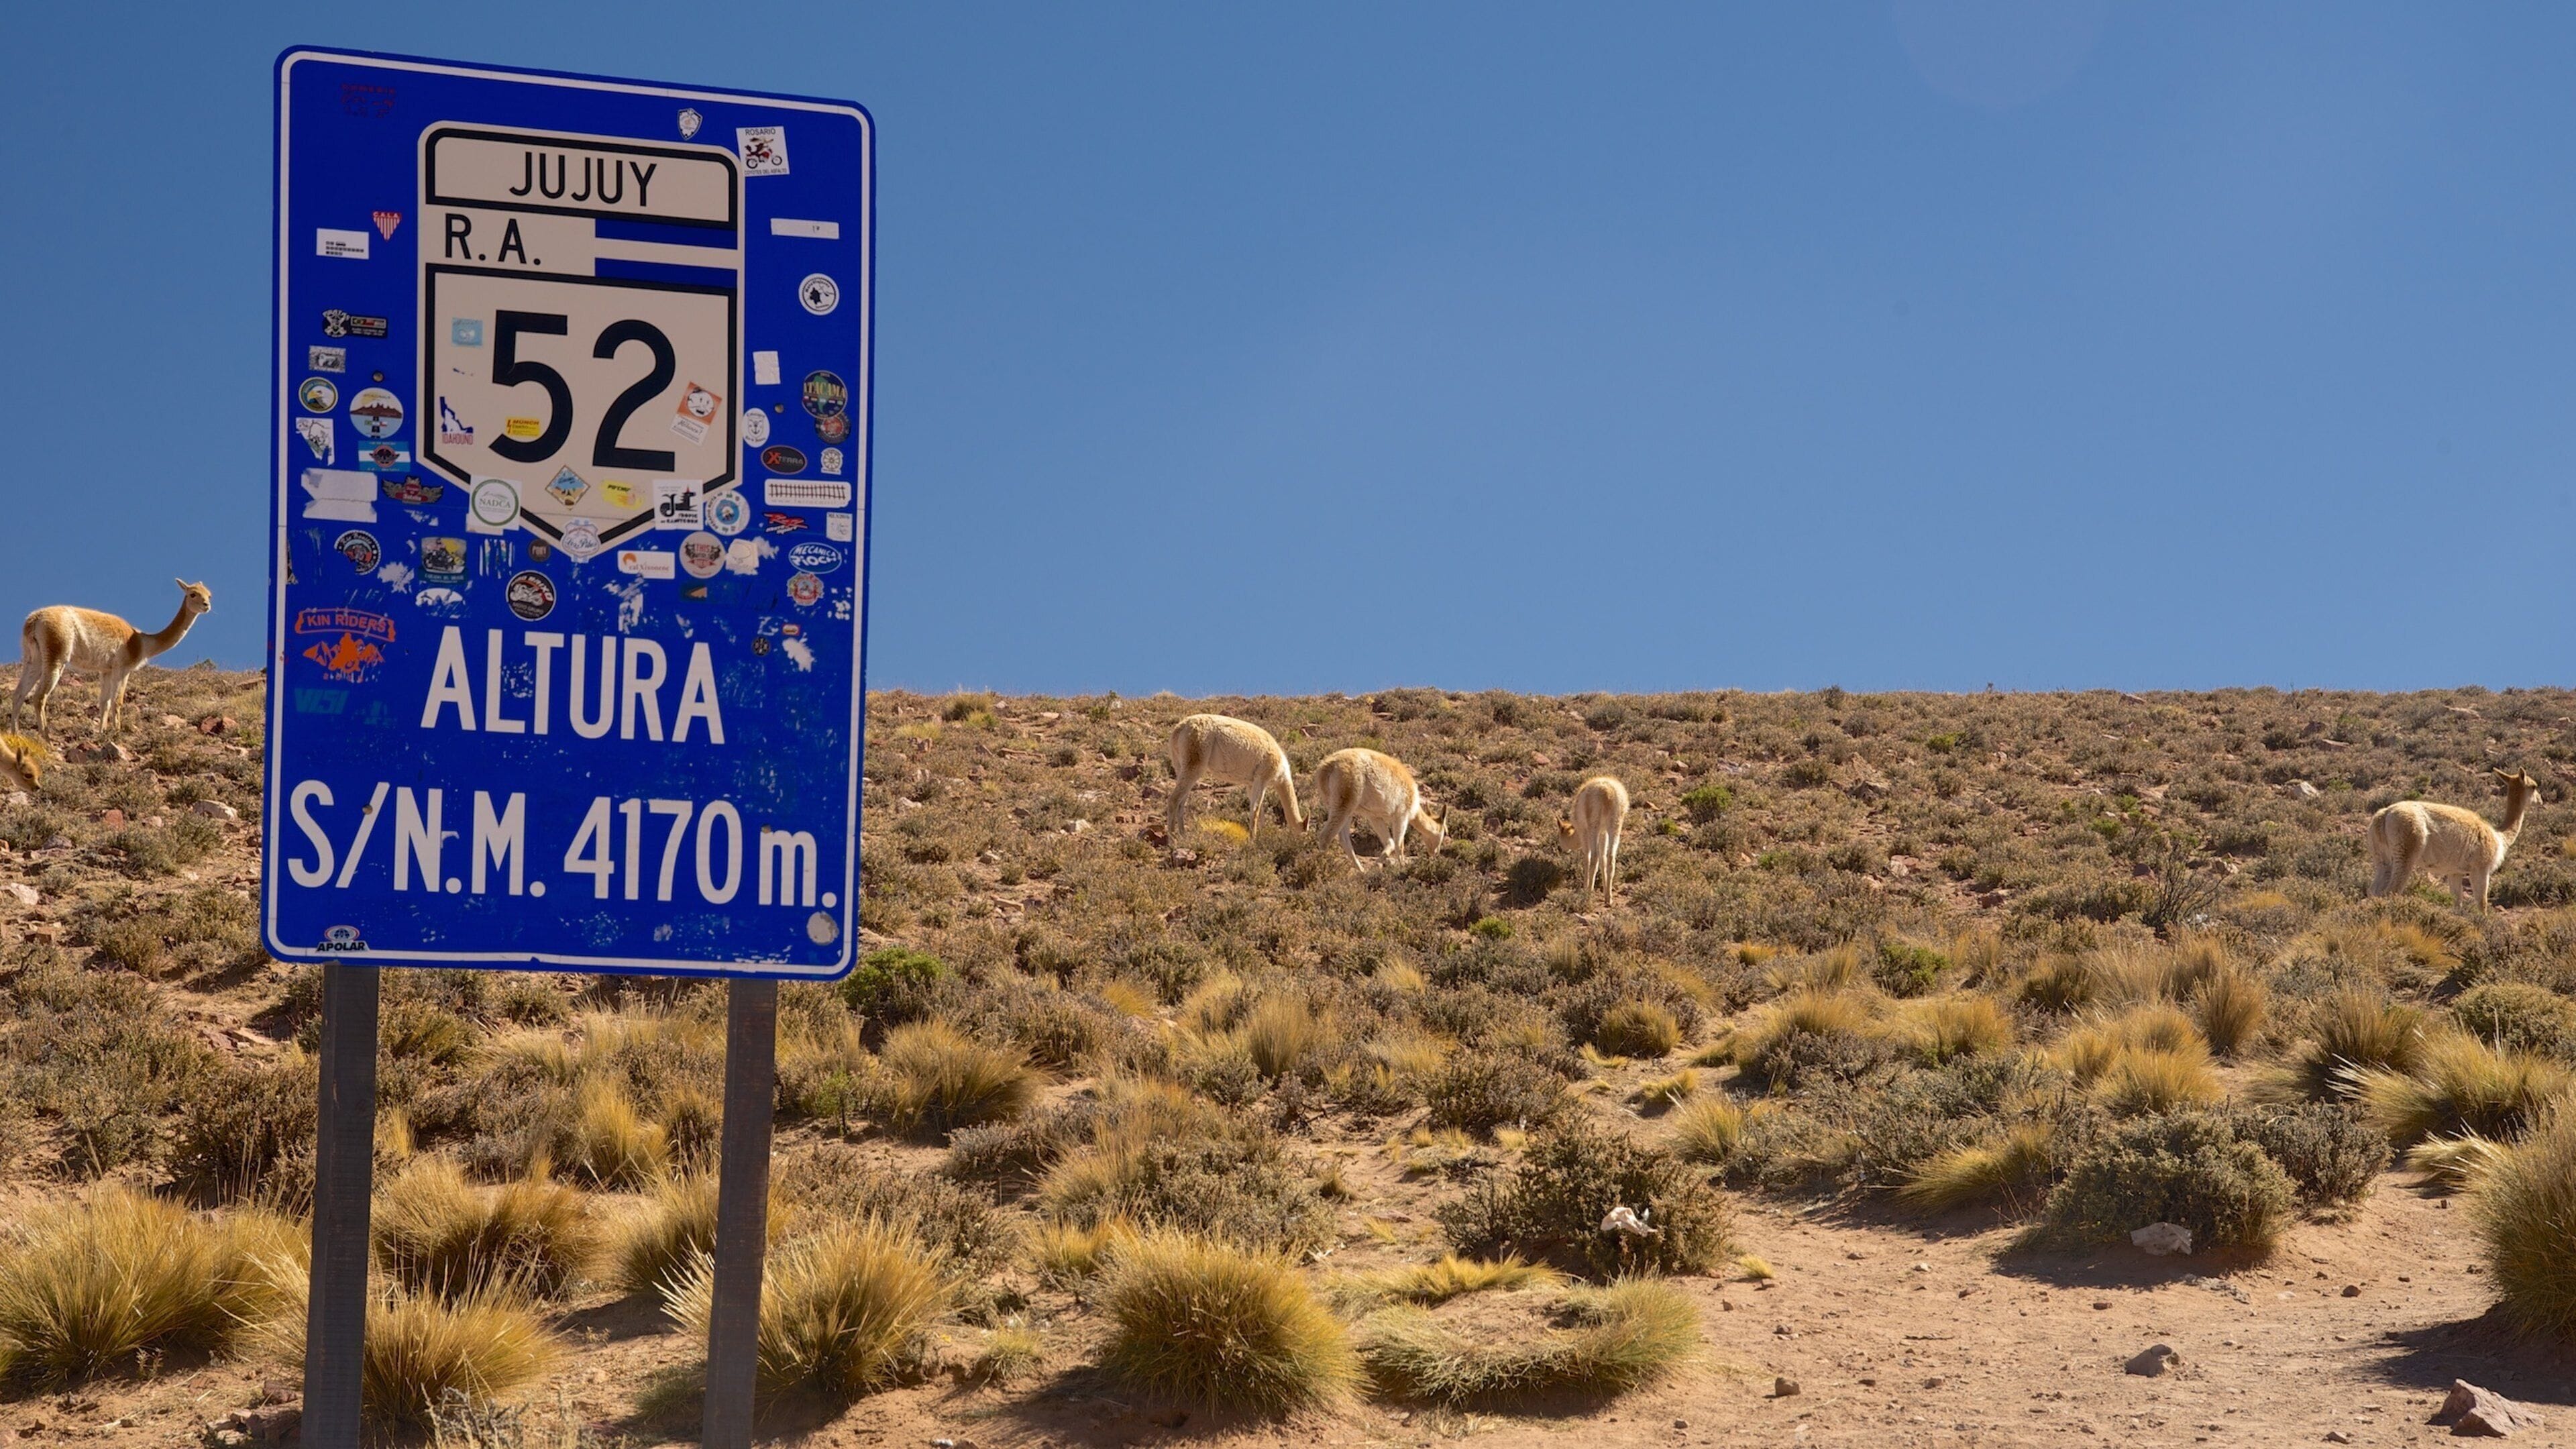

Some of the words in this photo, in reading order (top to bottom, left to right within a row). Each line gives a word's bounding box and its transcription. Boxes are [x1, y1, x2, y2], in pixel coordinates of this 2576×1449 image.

[745, 127, 776, 136] ROSARIO
[508, 151, 658, 207] JUJUY
[444, 213, 541, 266] R.A.
[488, 309, 676, 472] 52
[803, 381, 847, 399] ATACAMA
[441, 433, 474, 445] IDAHOUND
[766, 451, 804, 465] XTERRA
[479, 498, 511, 508] NADCA
[794, 545, 837, 557] MECANICA
[307, 614, 331, 627] KIN
[335, 614, 387, 633] RIDERS
[421, 626, 724, 744] ALTURA
[288, 780, 545, 897] S/N.M.
[564, 796, 743, 904] 4170
[759, 827, 837, 908] m.
[317, 941, 366, 952] APOLAR
